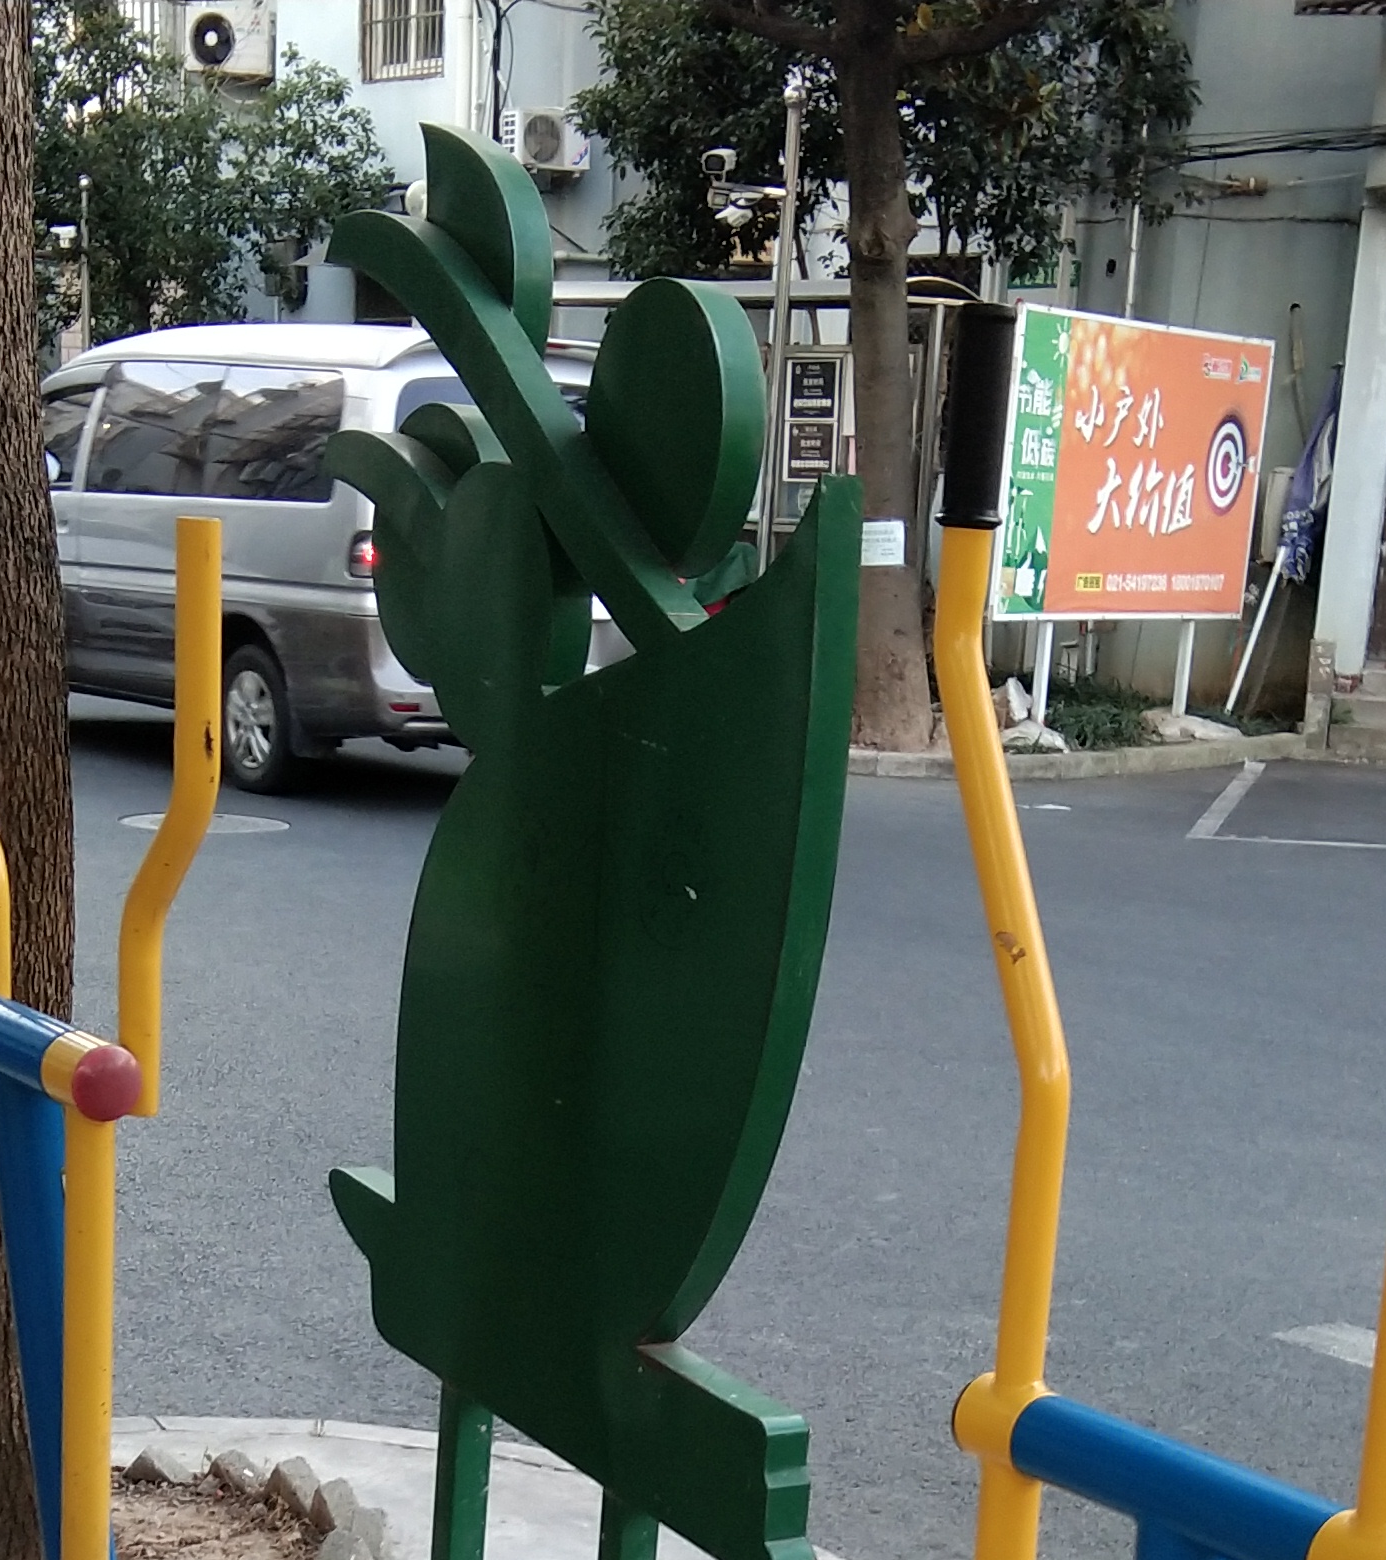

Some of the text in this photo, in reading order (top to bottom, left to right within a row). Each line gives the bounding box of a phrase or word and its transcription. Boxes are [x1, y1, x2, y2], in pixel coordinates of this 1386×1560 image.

[1018, 378, 1054, 416] 节能
[1075, 385, 1163, 449] 小户外
[1021, 428, 1056, 468] 低碳
[1086, 457, 1194, 538] 大价值
